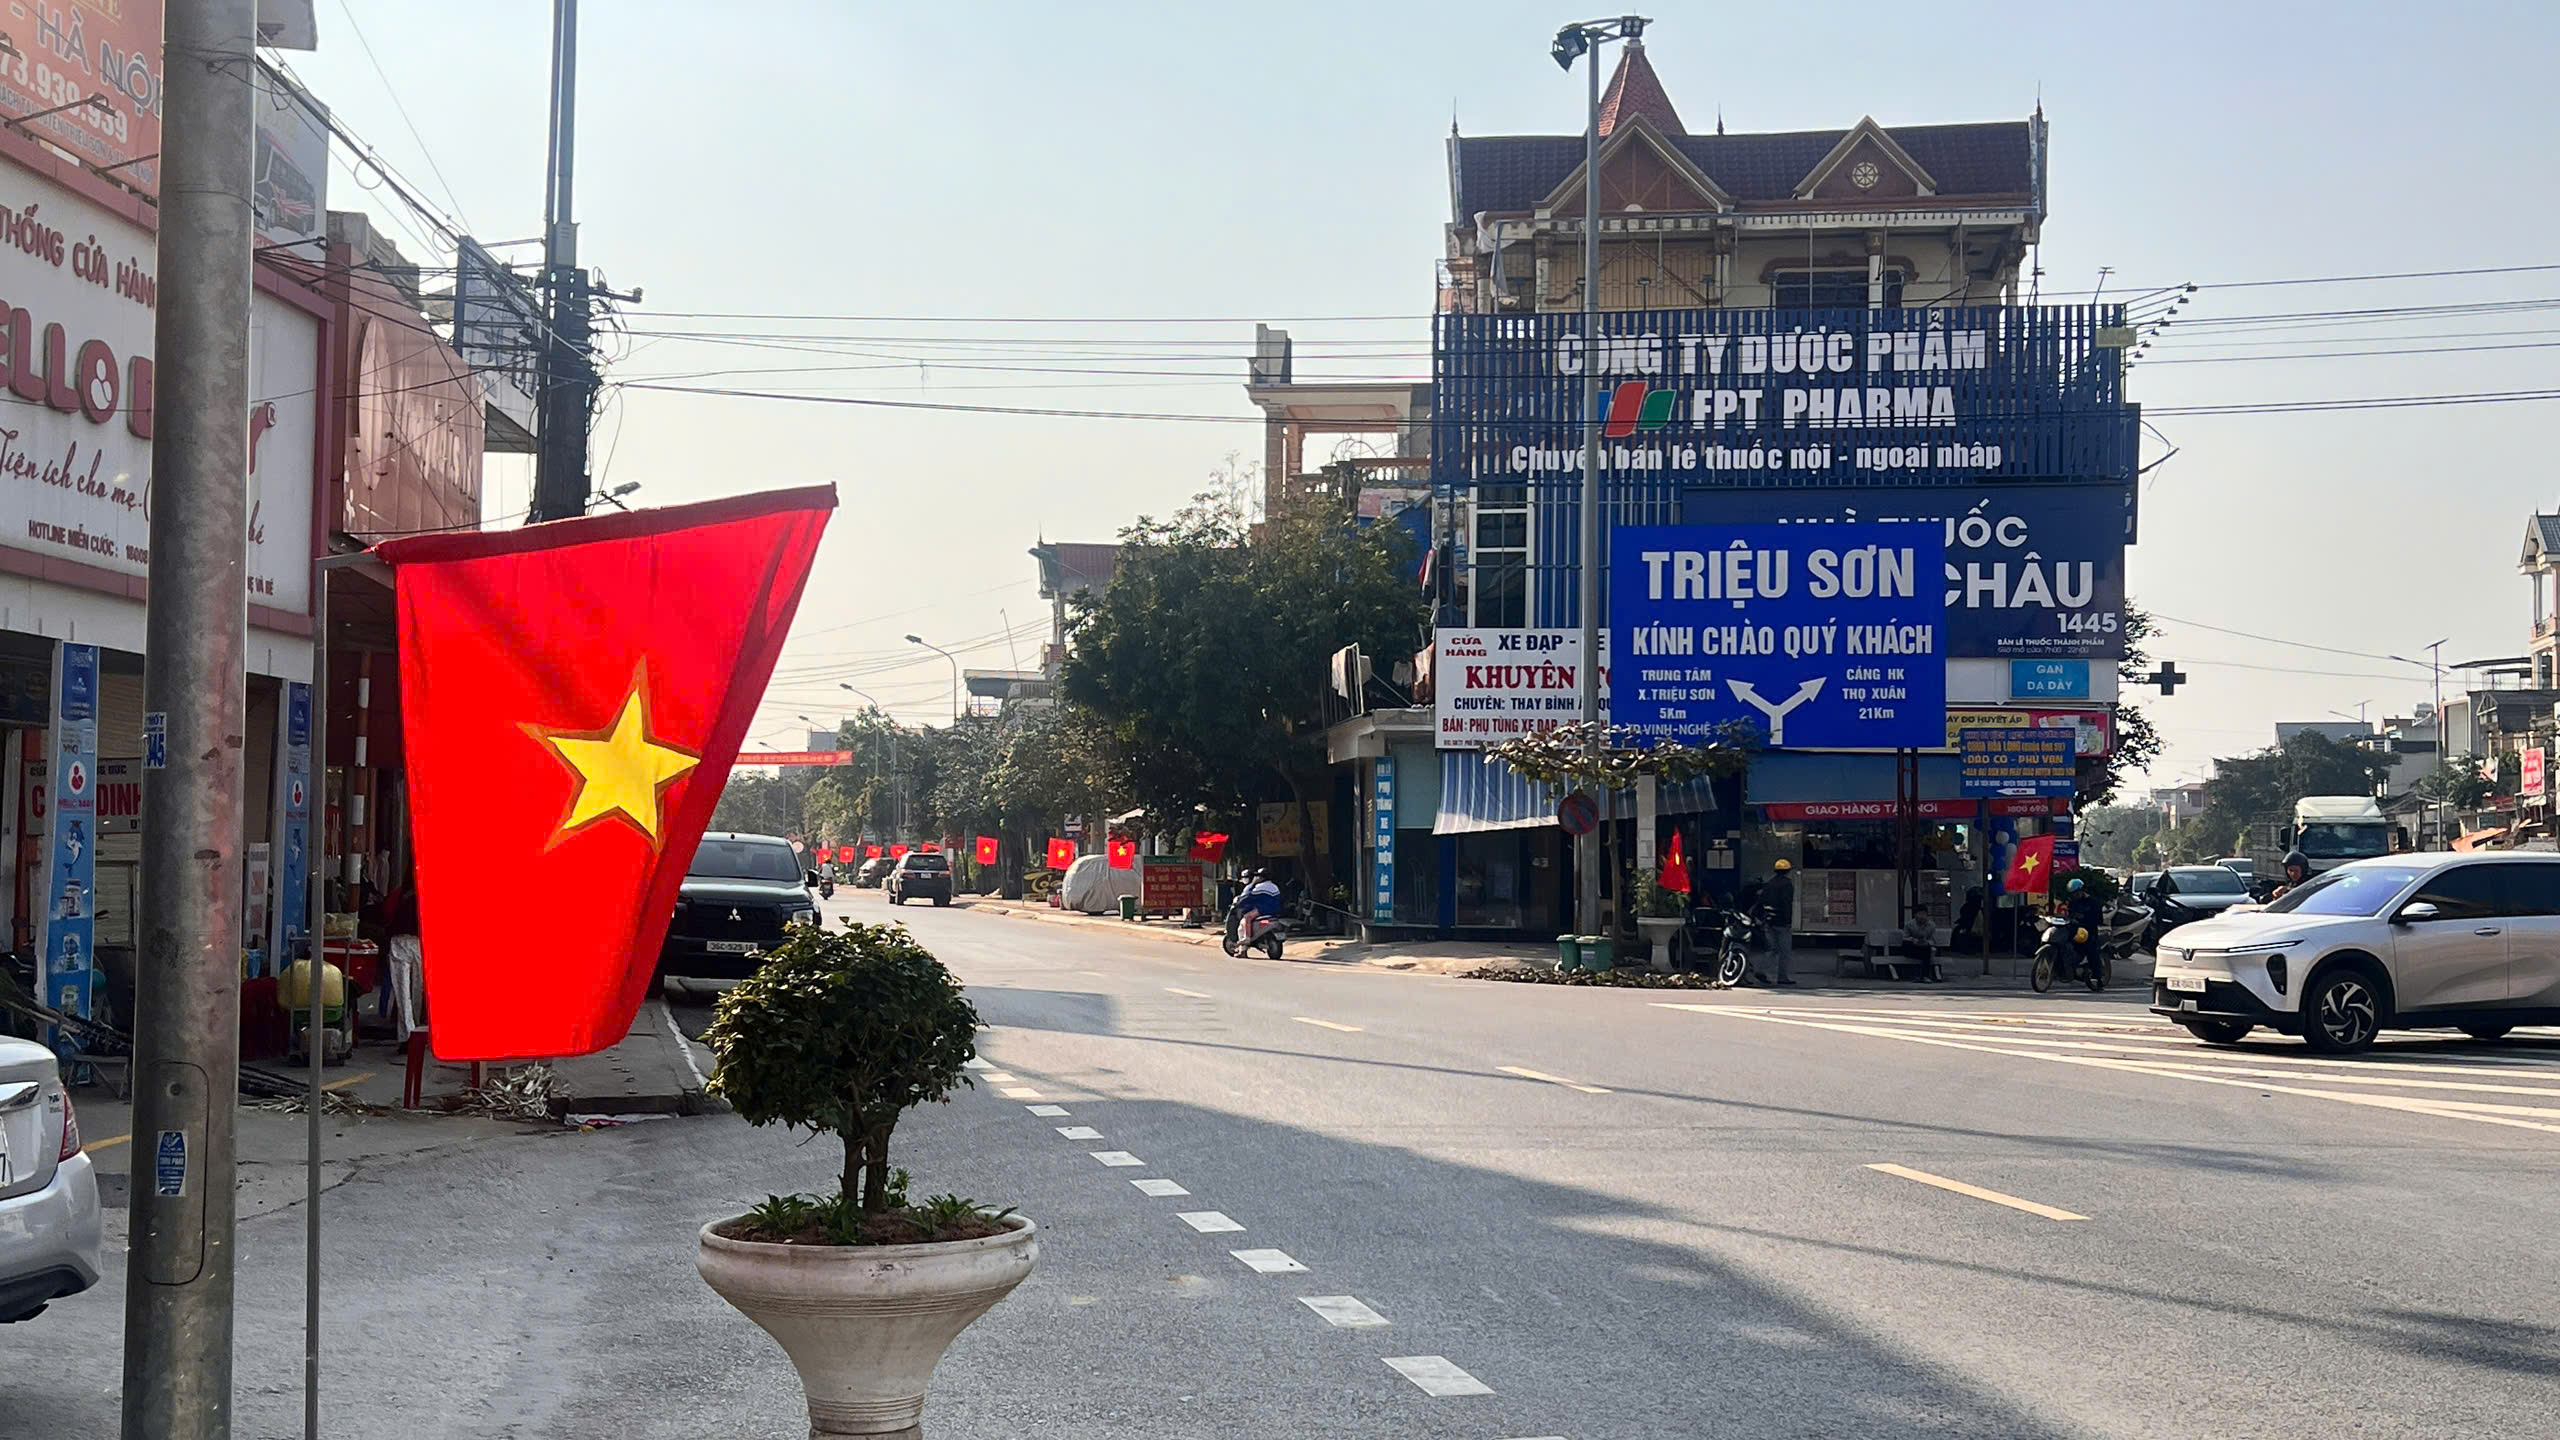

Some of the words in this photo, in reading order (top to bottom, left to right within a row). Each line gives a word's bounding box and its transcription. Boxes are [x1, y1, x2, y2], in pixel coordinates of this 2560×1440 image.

[73, 234, 109, 288] CỬA
[117, 256, 157, 309] HÀN
[1677, 333, 1729, 375] TY
[1741, 325, 1854, 380] DƯỢC
[1867, 311, 1985, 372] PHẨM
[1693, 389, 1763, 429] FPT
[1784, 387, 1957, 429] PHARMA
[1614, 443, 1663, 471] bán
[1672, 443, 1696, 471] lẻ
[1705, 440, 1782, 471] thuốc
[1790, 443, 1830, 474] nội
[1856, 442, 1927, 474] ngoại
[1641, 539, 1789, 608] TRIỆU
[1807, 545, 1914, 598] SƠN
[2057, 612, 2117, 634] 1445
[1498, 635, 1521, 650] XE
[1526, 635, 1563, 654] ĐẠP
[1633, 620, 1694, 655] KÍNH
[1703, 618, 1774, 655] CHÀO
[1784, 617, 1837, 658] QUÝ
[1847, 618, 1932, 655] KHÁCH
[1445, 646, 1487, 657] HÀNG
[1465, 660, 1576, 689] KHUYÊN
[1641, 668, 1682, 681] TRUNG
[1685, 666, 1712, 681] TÂM
[1846, 664, 1880, 680] CẢNG
[1888, 668, 1905, 680] HK
[2035, 665, 2064, 675] GAN
[1690, 687, 1716, 700] SƠN
[1843, 687, 1867, 702] THỌ
[1871, 685, 1905, 699] XUÂN
[2027, 681, 2045, 694] DẠ
[2048, 679, 2073, 691] DÀY
[1454, 695, 1506, 711] CHUYÊN:
[1511, 697, 1541, 710] THAY
[1545, 694, 1575, 710] BÌNH
[1660, 707, 1687, 719] 5Km
[1859, 705, 1895, 719] 21Km
[1469, 719, 1488, 736] PHỤ
[1491, 716, 1519, 733] TÙNG
[1521, 719, 1534, 732] XE
[1804, 804, 1839, 815] GIAO
[1843, 800, 1881, 814] HÀNG
